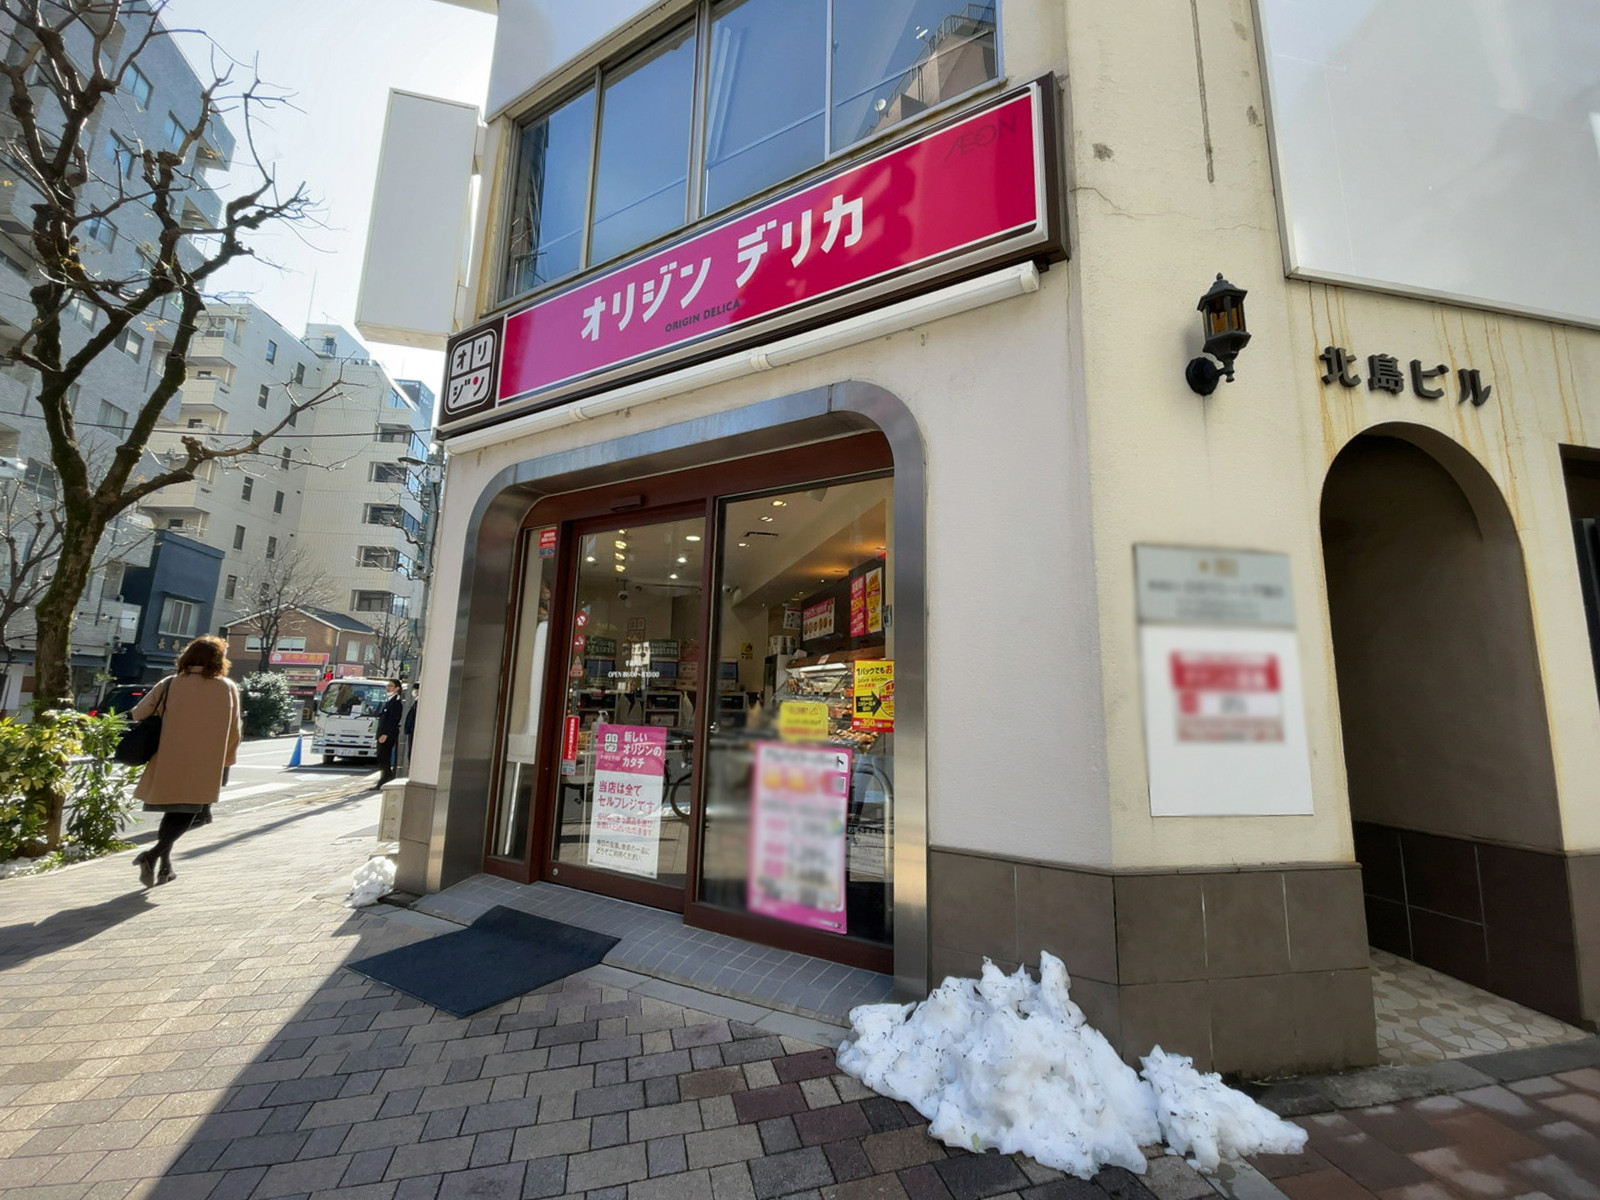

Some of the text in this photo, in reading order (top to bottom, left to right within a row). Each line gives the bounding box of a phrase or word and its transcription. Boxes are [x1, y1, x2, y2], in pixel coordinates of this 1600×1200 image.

[580, 194, 864, 342] オリジン デリカ
[664, 298, 741, 333] ORIGIN DELICA
[1318, 346, 1492, 408] 北島ビル
[624, 730, 648, 743] 新しい
[623, 743, 662, 757] オリジンの
[622, 757, 645, 769] カタチ
[598, 781, 642, 796] 当店は全て
[598, 796, 655, 814] セルフレジです
